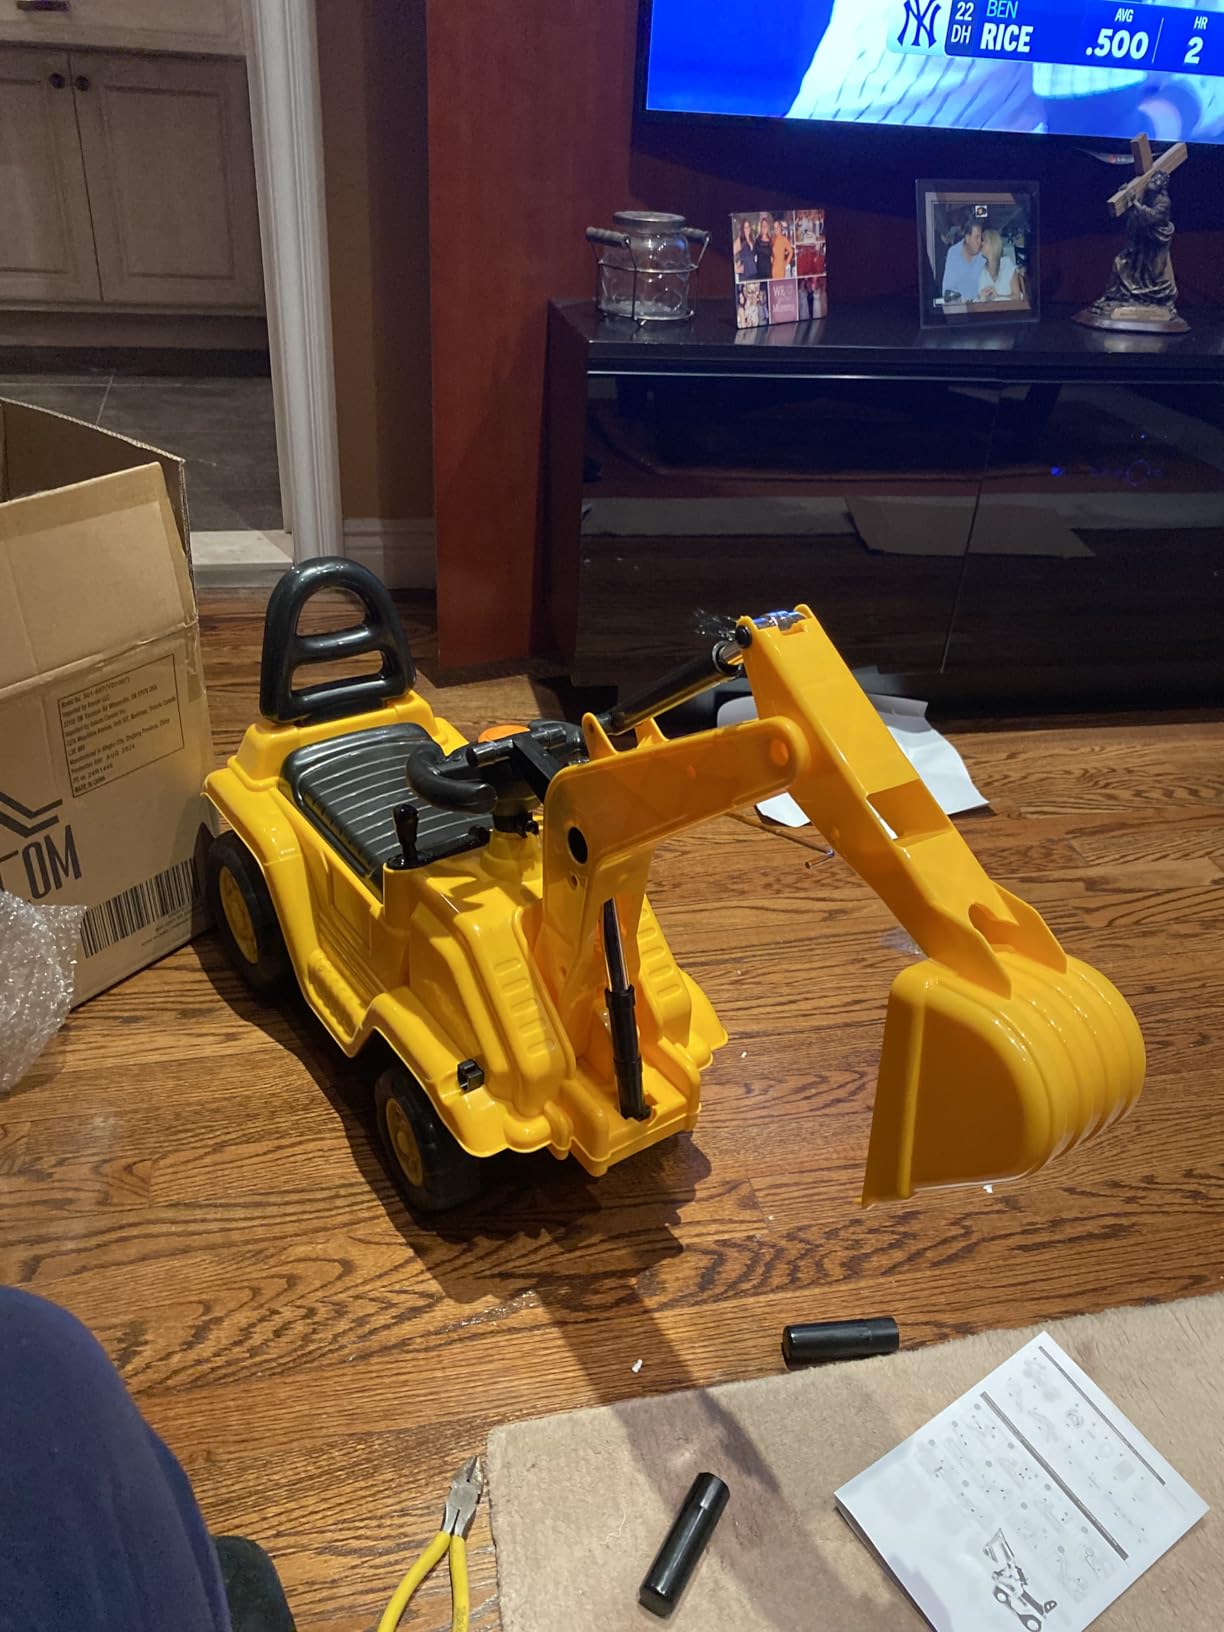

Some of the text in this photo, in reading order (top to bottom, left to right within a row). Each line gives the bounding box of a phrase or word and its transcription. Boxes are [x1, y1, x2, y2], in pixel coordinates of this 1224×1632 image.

[955, 2, 974, 21] 22
[986, 0, 1018, 19] BEN
[1114, 7, 1134, 23] AVG
[1193, 16, 1208, 30] HR
[951, 24, 972, 44] DH
[980, 22, 1034, 53] RICE
[1085, 28, 1149, 60] .500
[1183, 36, 1204, 64] 2
